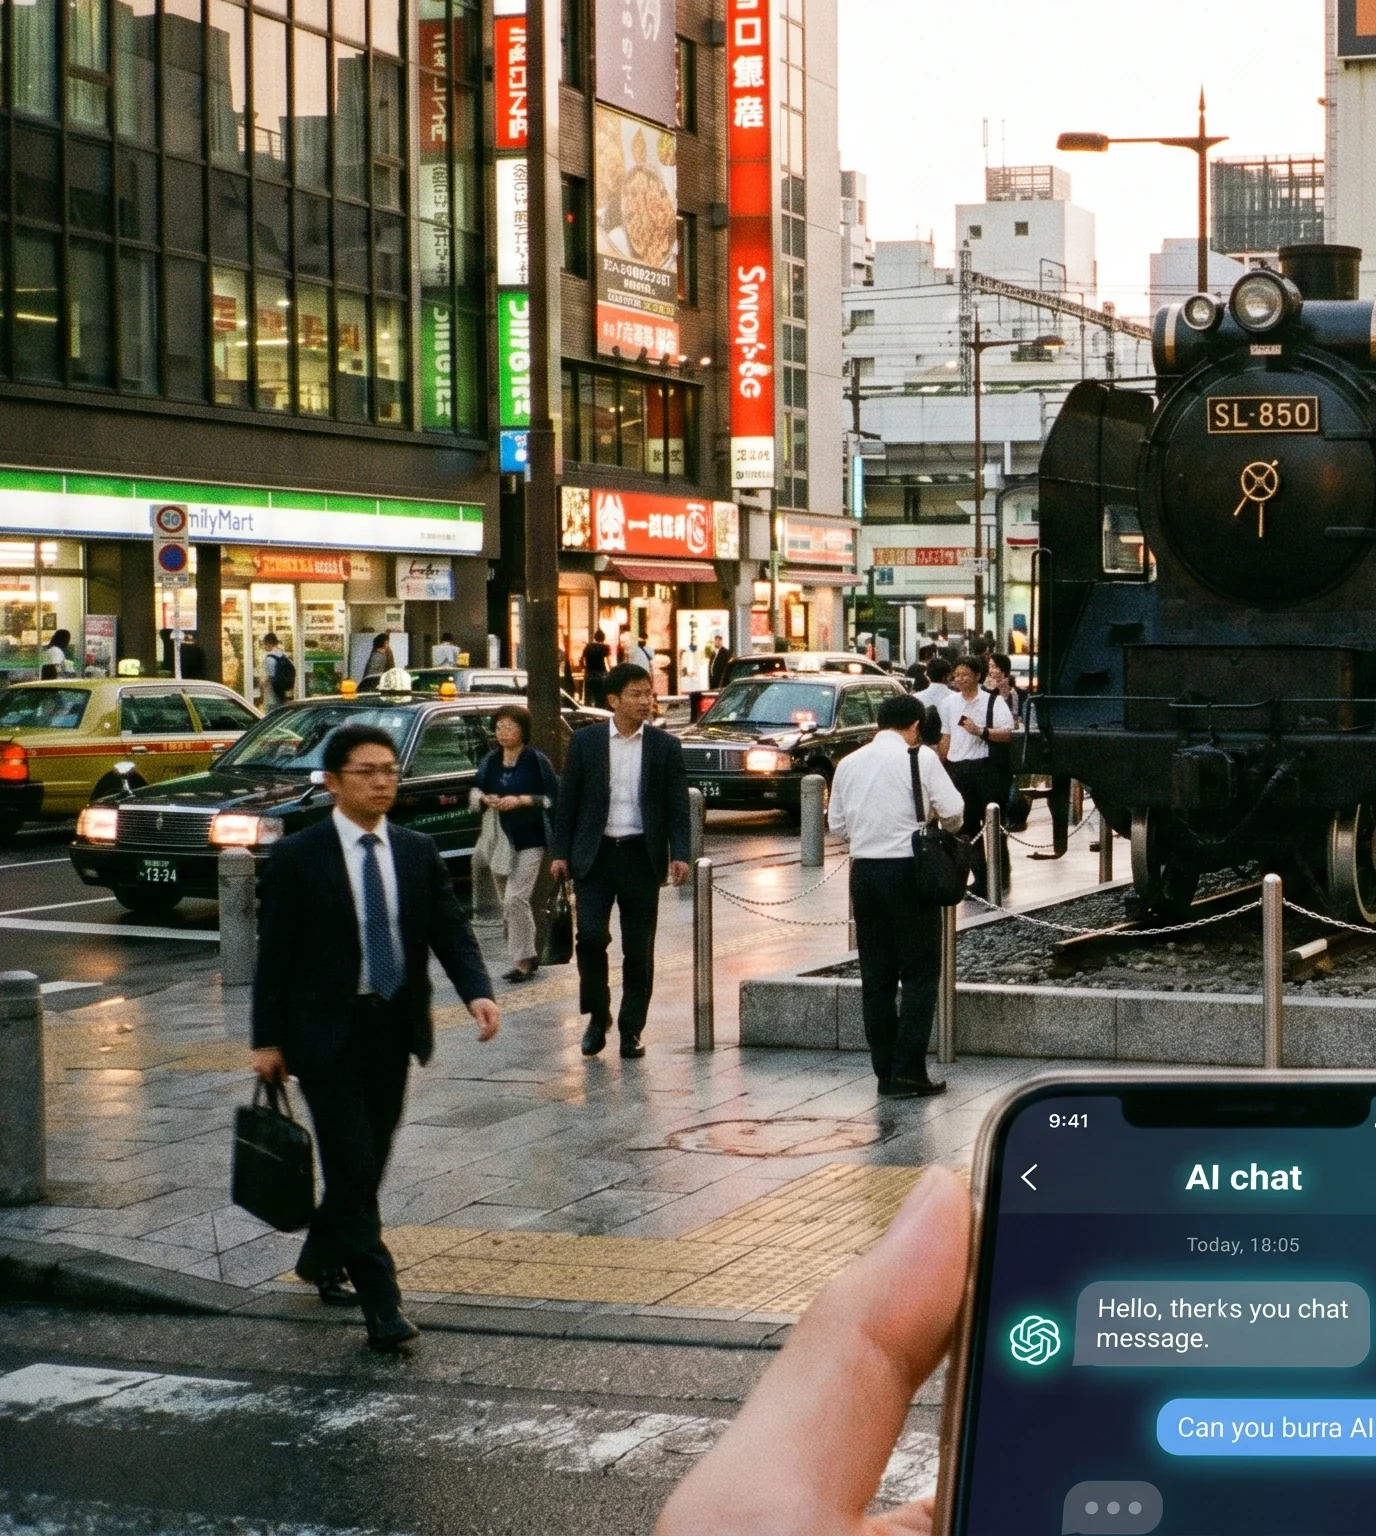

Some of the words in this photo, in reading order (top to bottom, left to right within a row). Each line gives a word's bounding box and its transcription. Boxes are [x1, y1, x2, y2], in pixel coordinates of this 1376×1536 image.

[1215, 402, 1310, 427] SL-850
[188, 508, 254, 534] milyMart
[1049, 1113, 1088, 1128] 9:41
[1185, 1164, 1219, 1190] AI
[1230, 1162, 1303, 1190] chat
[1187, 1237, 1243, 1256] Today,
[1250, 1237, 1300, 1252] 18:05
[1098, 1297, 1162, 1321] Hello,
[1249, 1303, 1290, 1324] you
[1298, 1297, 1349, 1319] chat
[1096, 1332, 1209, 1354] message.
[1178, 1416, 1224, 1438] Can
[1231, 1421, 1274, 1443] you
[1350, 1417, 1373, 1438] AI
